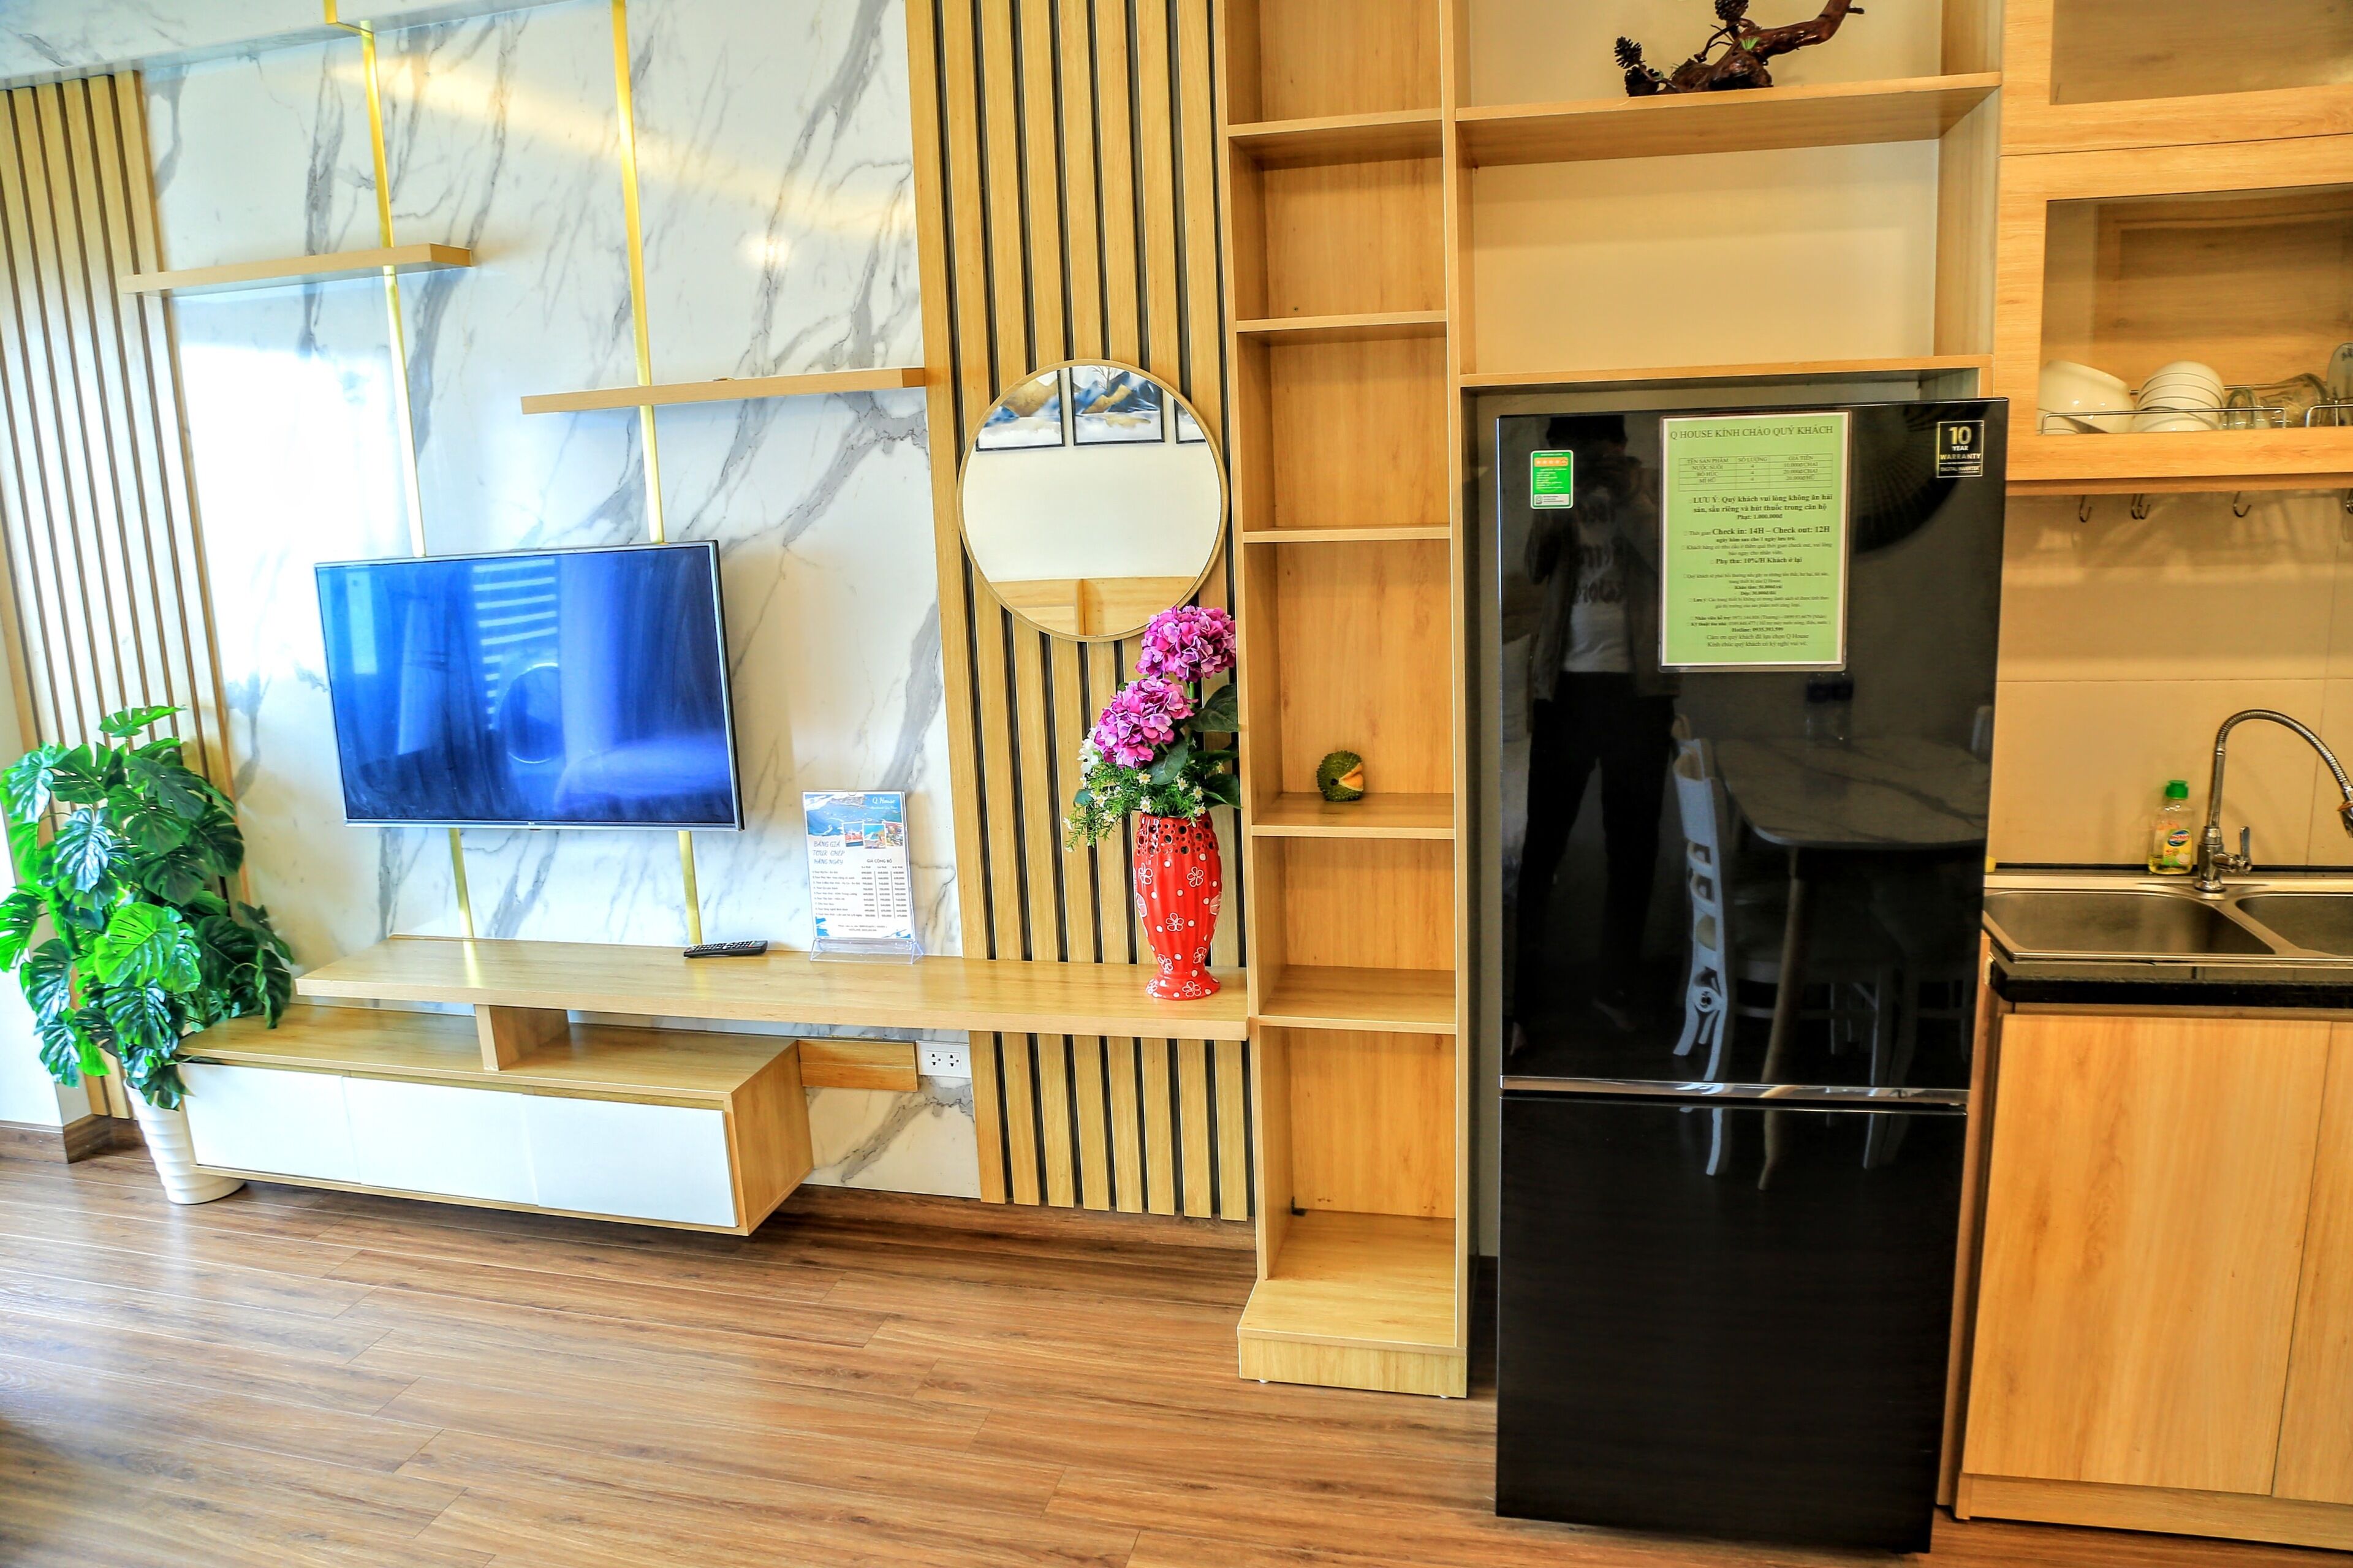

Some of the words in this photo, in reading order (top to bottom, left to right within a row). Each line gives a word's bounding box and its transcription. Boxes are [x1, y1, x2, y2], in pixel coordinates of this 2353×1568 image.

[1670, 431, 1678, 440] Q
[1716, 427, 1740, 437] KÍNH
[1743, 426, 1771, 436] CHÀO
[1773, 425, 1794, 436] QUÝ
[1798, 425, 1833, 434] KHÁCH
[1948, 426, 1972, 445] 10
